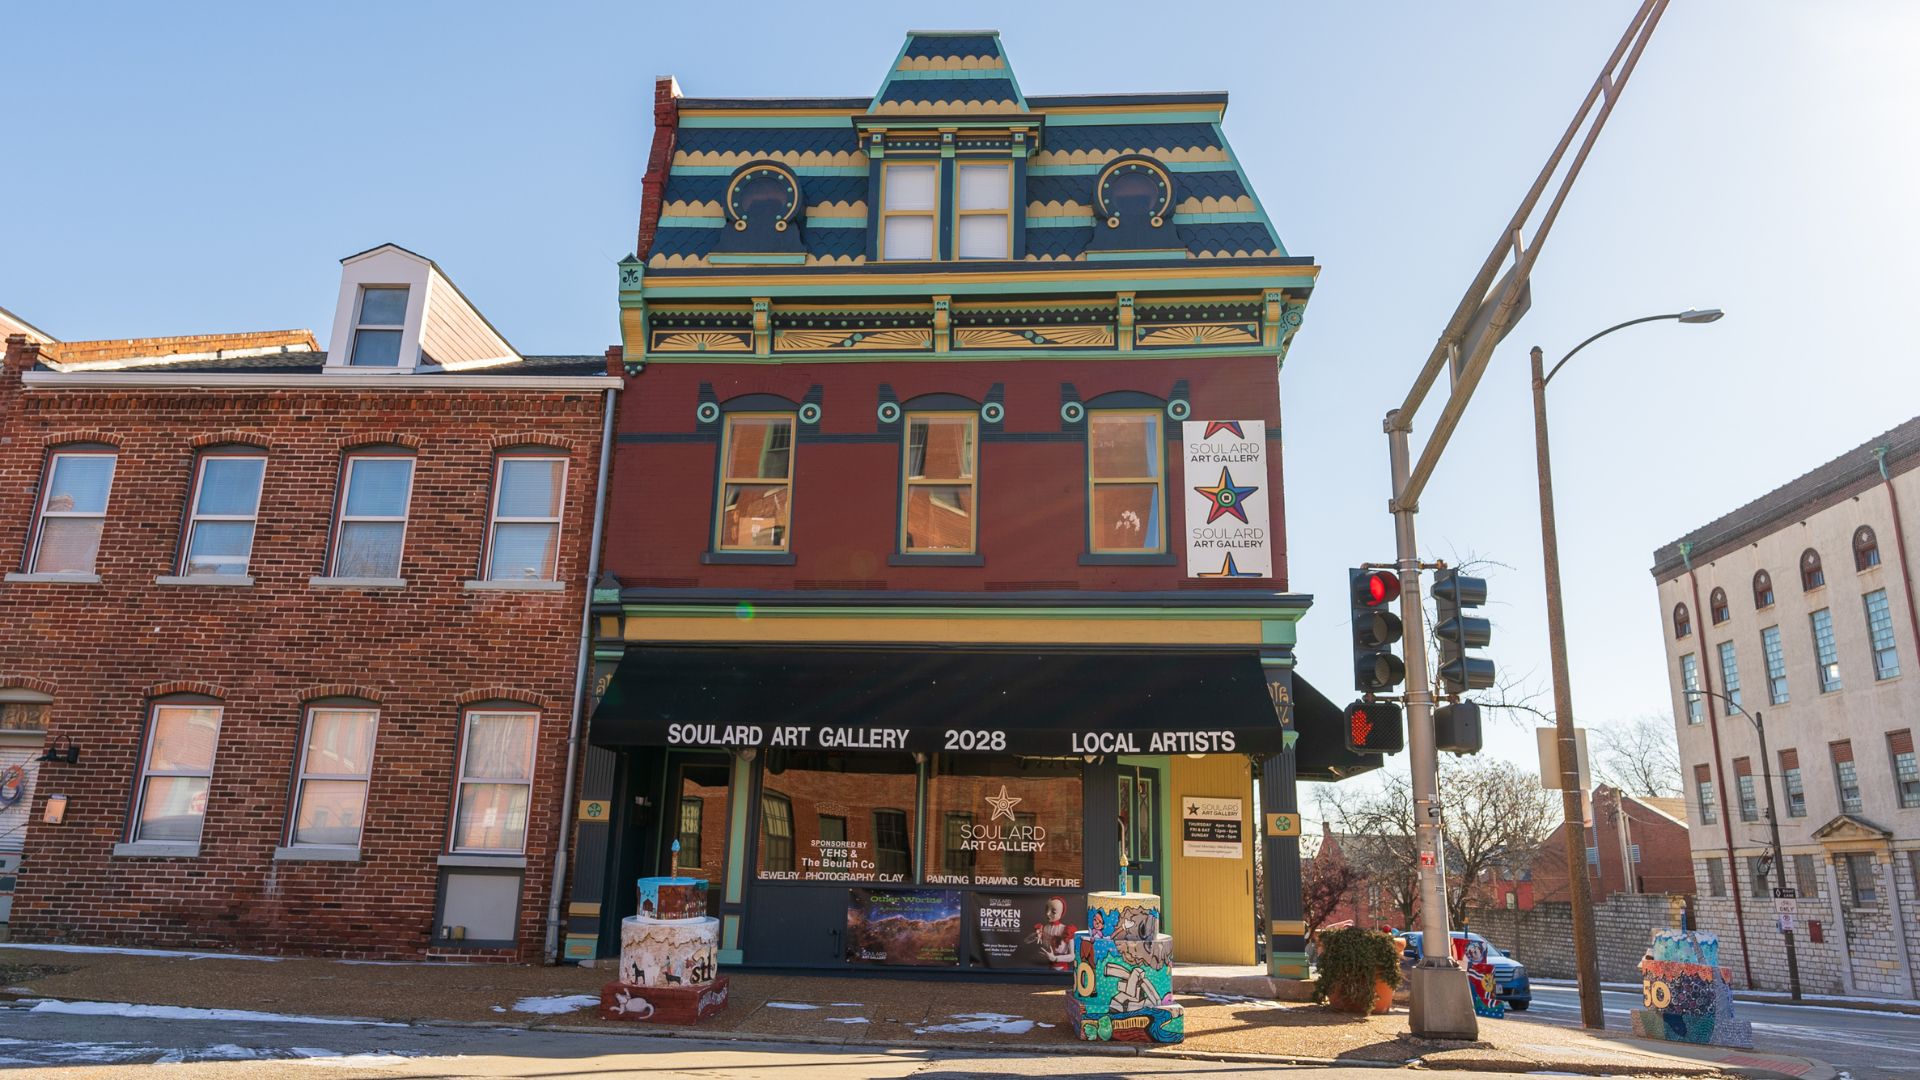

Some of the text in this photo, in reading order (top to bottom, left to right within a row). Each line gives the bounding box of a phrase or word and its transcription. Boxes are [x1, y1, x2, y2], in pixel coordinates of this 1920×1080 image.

[1190, 443, 1259, 454] SOULARD
[1213, 454, 1259, 462] GALLERY
[1192, 528, 1263, 539] SOULARD
[1193, 540, 1263, 548] ART GALLERY
[667, 723, 910, 749] SOULARD ART GALLERY
[944, 730, 1006, 750] 2028
[1072, 731, 1236, 753] LOCAL ARTISTS
[960, 824, 1046, 840] SOULARD
[810, 840, 856, 848] SPONSORED
[960, 840, 1045, 852] ART GALLERY
[819, 848, 858, 858] YEHS &
[801, 857, 875, 869] The Beulah Co
[757, 870, 904, 882] JEWELRY PHOTOGRAPHY CLAY
[926, 874, 1080, 887] PAINTING DRAWING SCULPTURE
[870, 895, 900, 903] Other
[980, 918, 1020, 928] HEARTS
[1643, 980, 1671, 1008] 50
